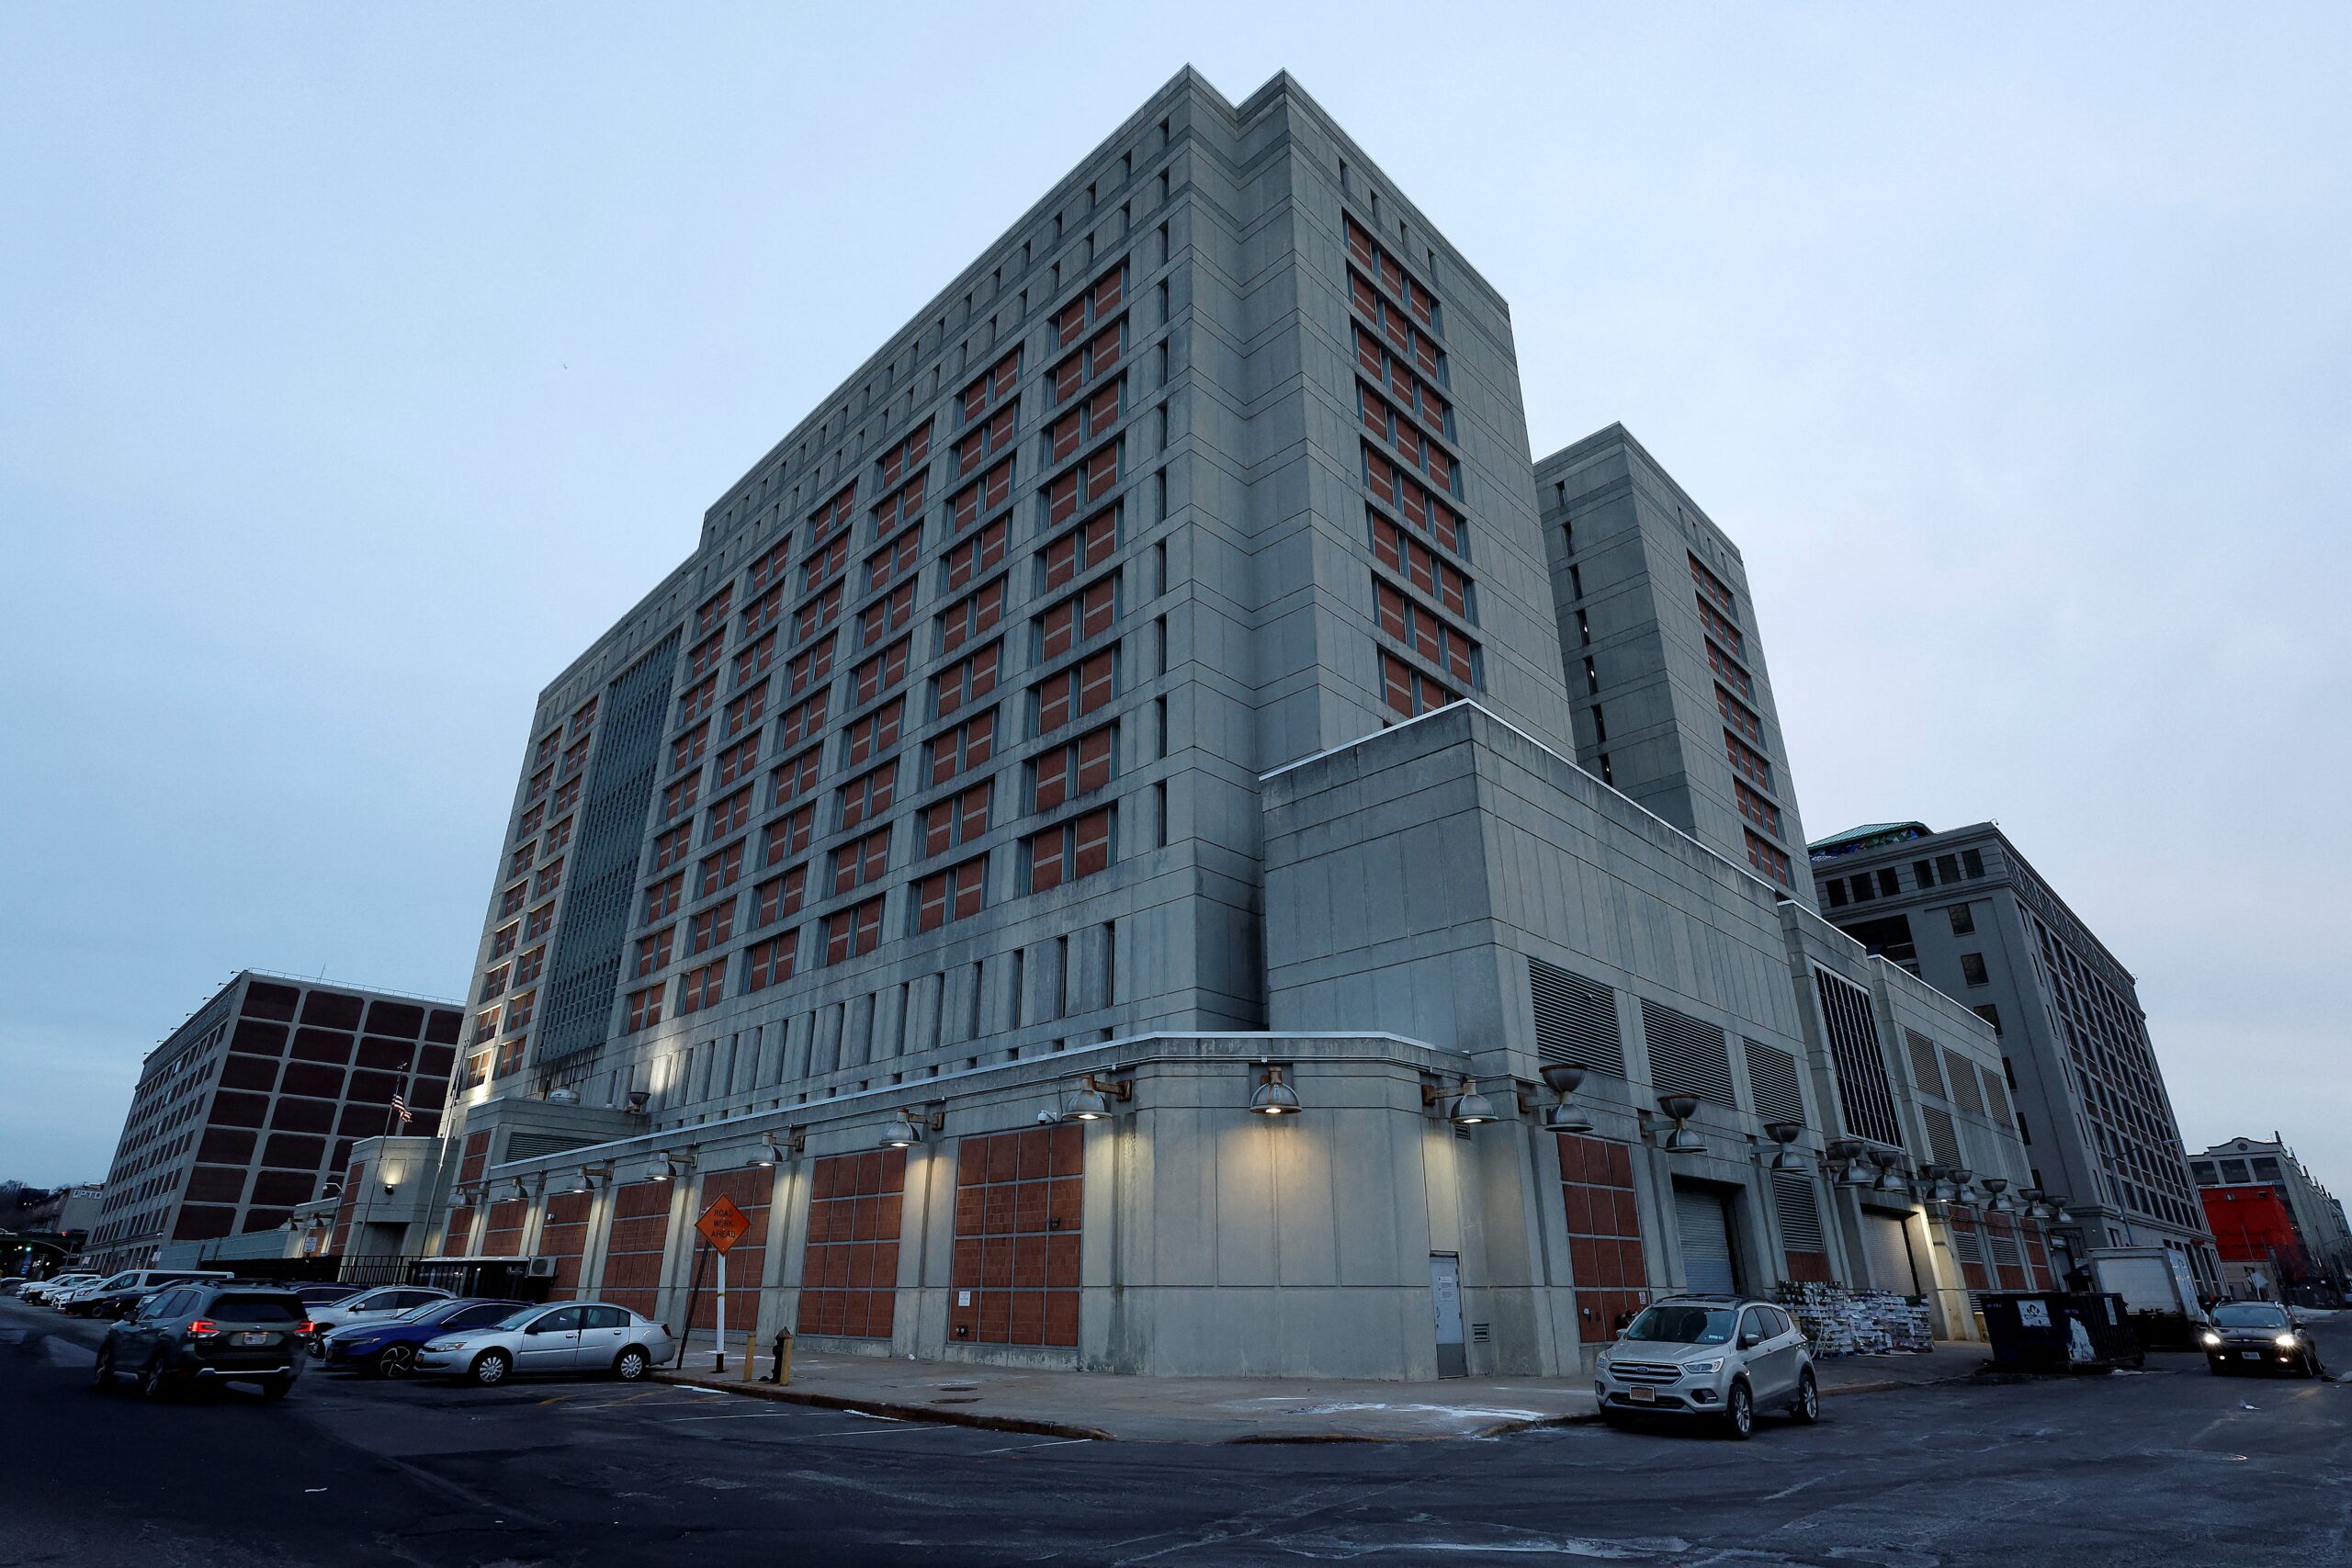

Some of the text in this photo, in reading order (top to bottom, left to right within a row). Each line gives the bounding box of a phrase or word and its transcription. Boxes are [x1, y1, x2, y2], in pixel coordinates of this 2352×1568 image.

[714, 1209, 734, 1217] ROAD
[713, 1220, 734, 1228] WORK
[711, 1230, 736, 1238] AHEAD
